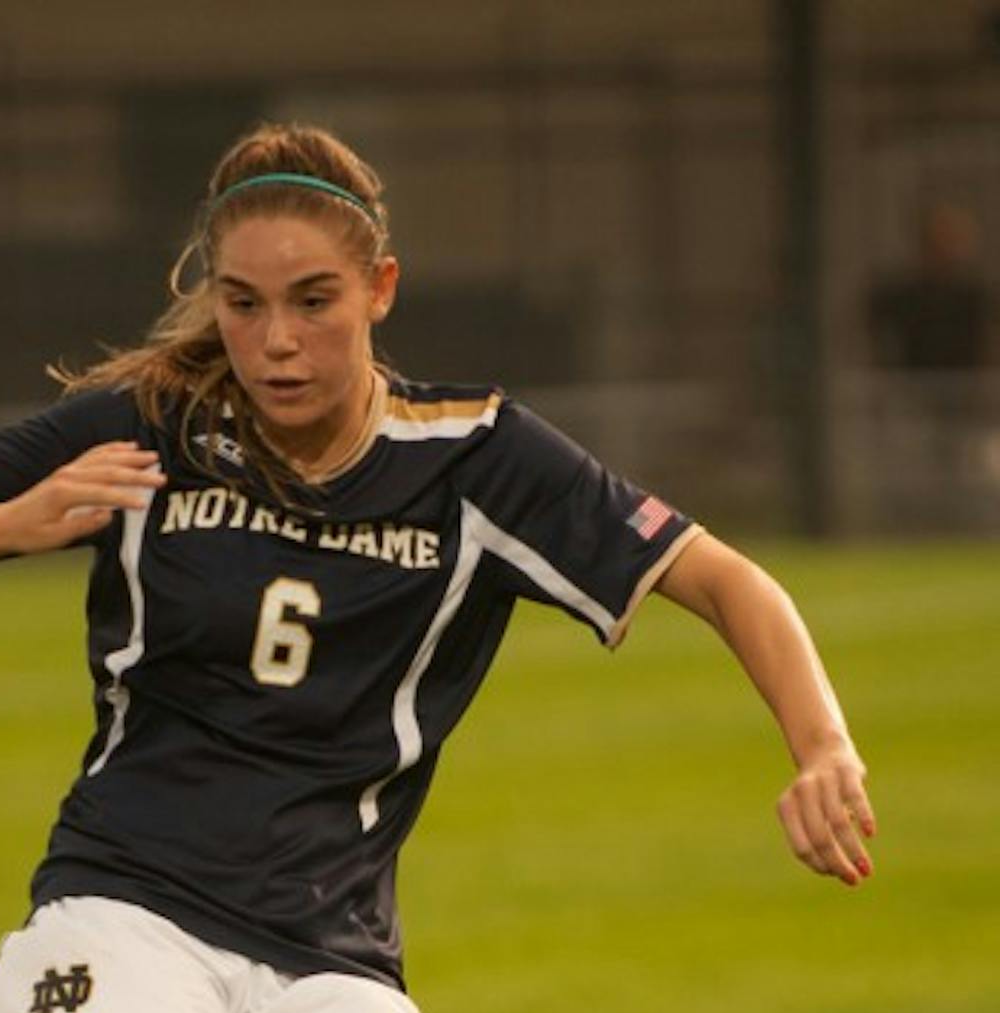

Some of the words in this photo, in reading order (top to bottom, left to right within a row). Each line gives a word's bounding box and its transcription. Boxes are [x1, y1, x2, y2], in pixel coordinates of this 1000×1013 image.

[160, 487, 307, 543] NOTRE
[318, 521, 442, 570] DAME
[250, 577, 322, 688] 6
